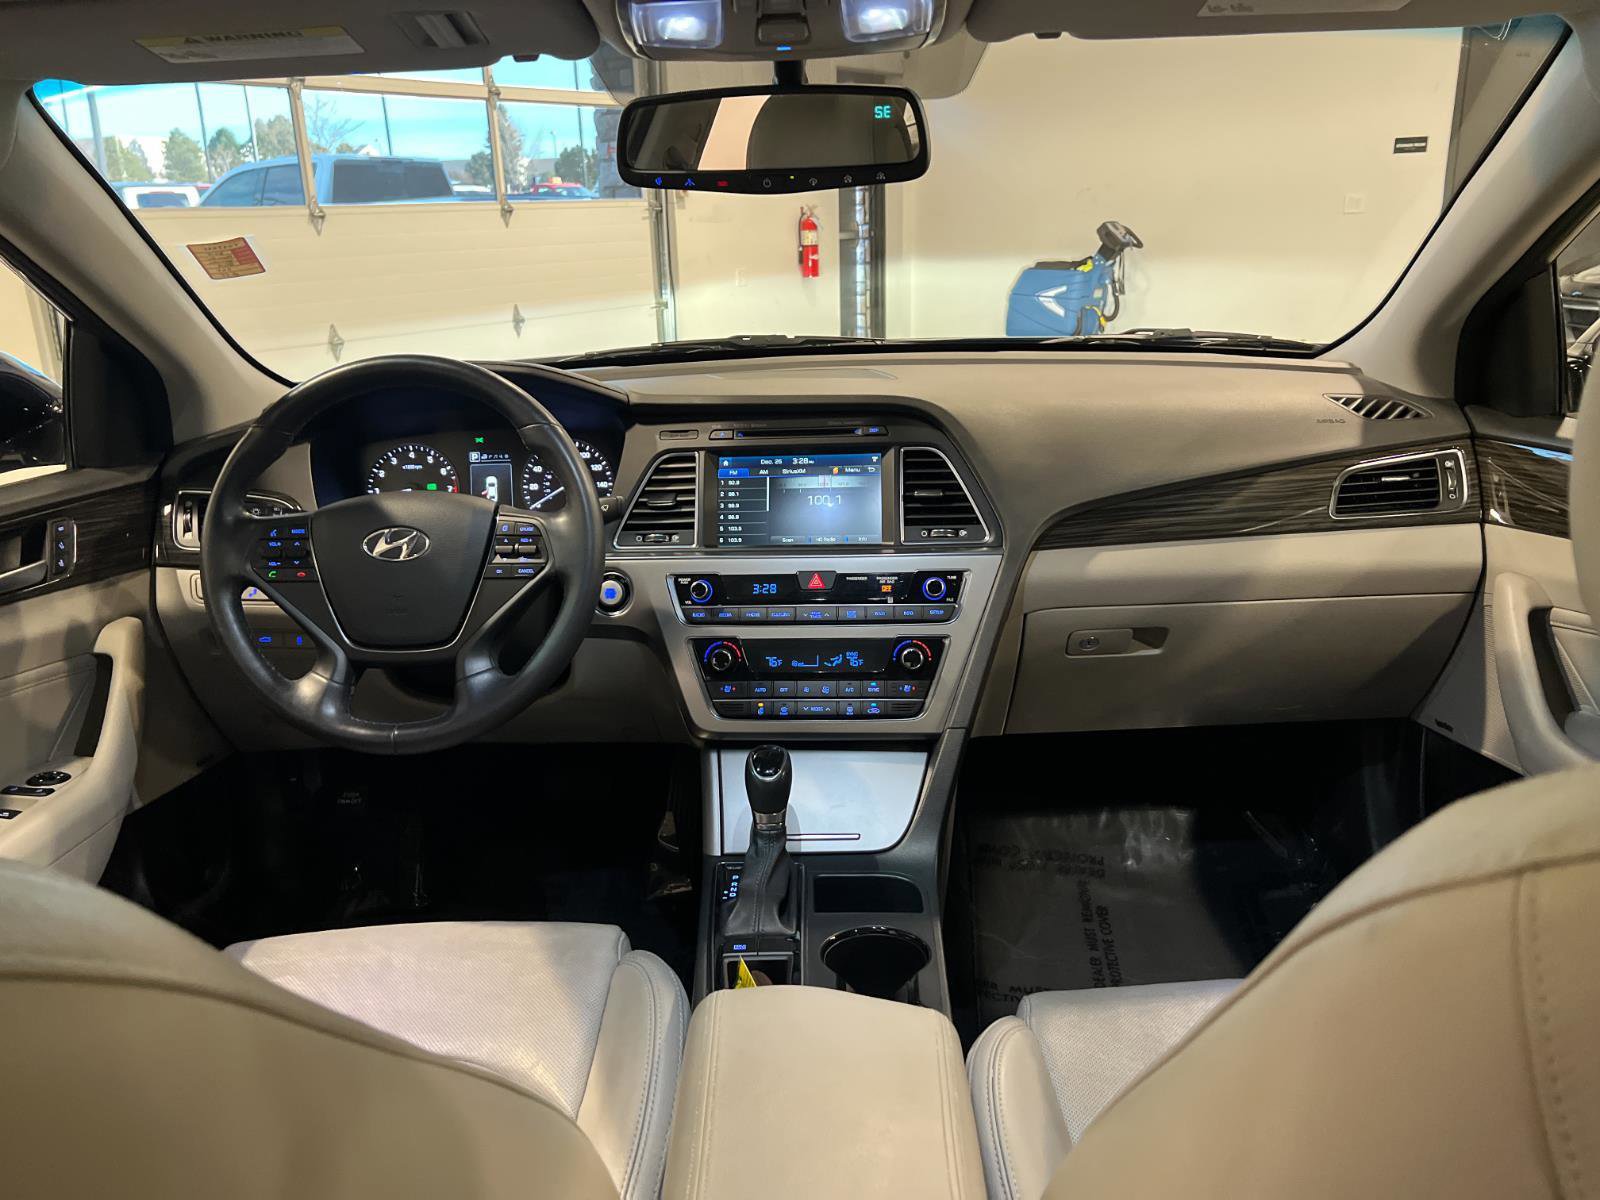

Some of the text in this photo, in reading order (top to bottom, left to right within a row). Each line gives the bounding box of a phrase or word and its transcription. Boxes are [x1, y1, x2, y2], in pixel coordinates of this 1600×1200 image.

[874, 106, 891, 119] SE
[408, 451, 415, 459] 4
[390, 457, 397, 465] 3
[426, 455, 433, 464] 5
[792, 457, 809, 465] 3:28
[378, 470, 385, 478] 2
[440, 467, 447, 476] 6
[374, 487, 380, 495] 1
[447, 485, 453, 493] 7
[752, 583, 777, 594] 3:28
